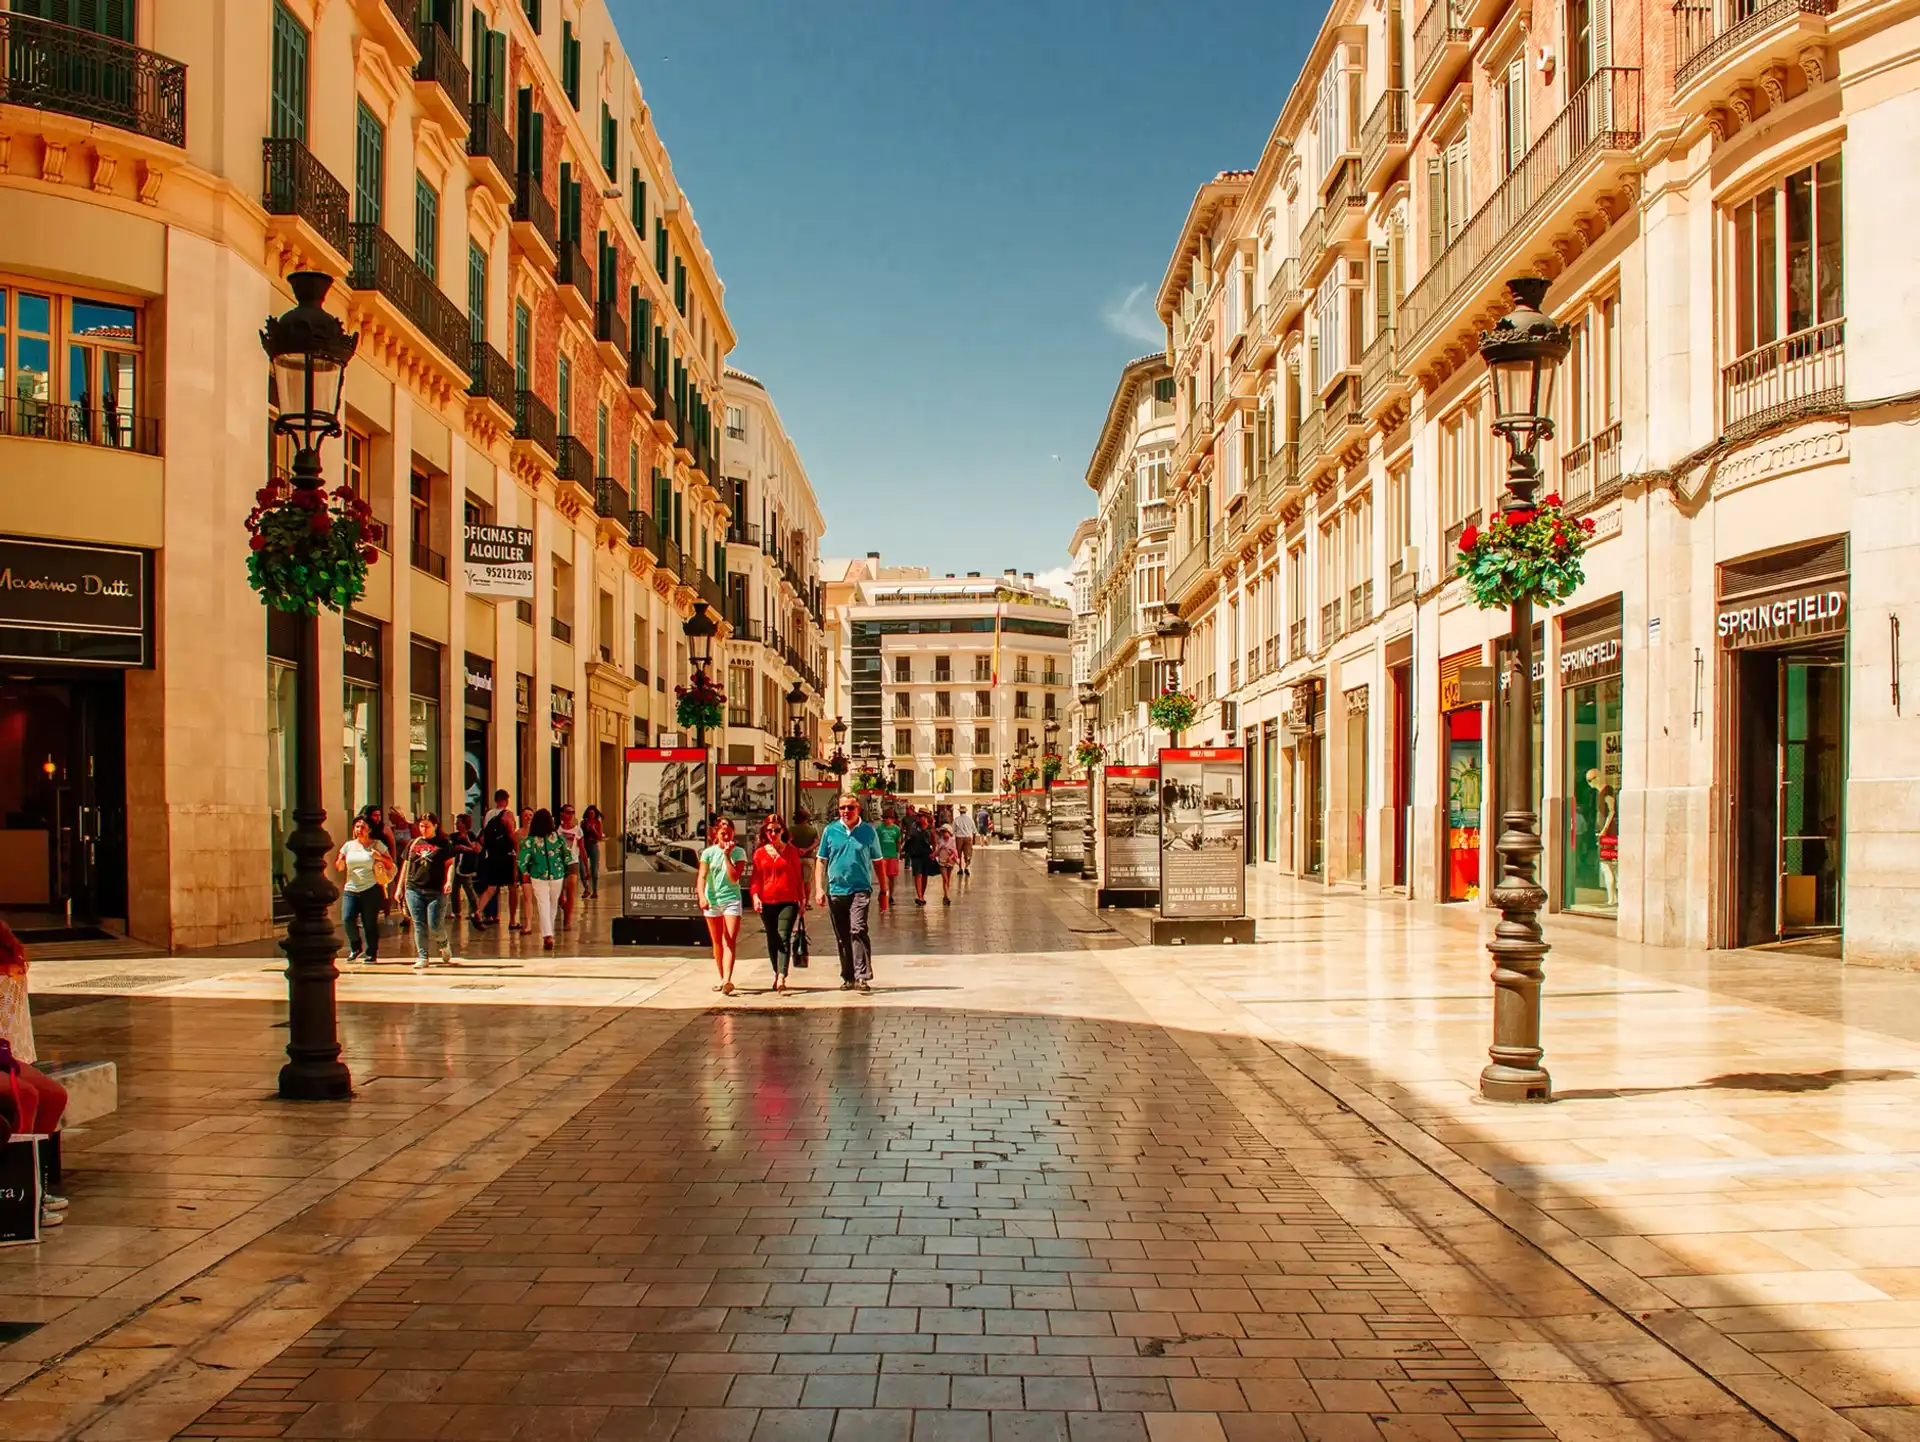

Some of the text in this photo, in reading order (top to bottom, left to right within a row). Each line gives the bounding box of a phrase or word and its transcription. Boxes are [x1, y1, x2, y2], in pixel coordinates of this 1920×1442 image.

[518, 531, 532, 546] EN
[470, 543, 524, 562] ALQUILER
[486, 567, 533, 581] 952121205
[81, 574, 134, 597] Dutti
[1717, 591, 1842, 637] SPRINGFIELD
[1560, 639, 1617, 673] SPRINGFIELD
